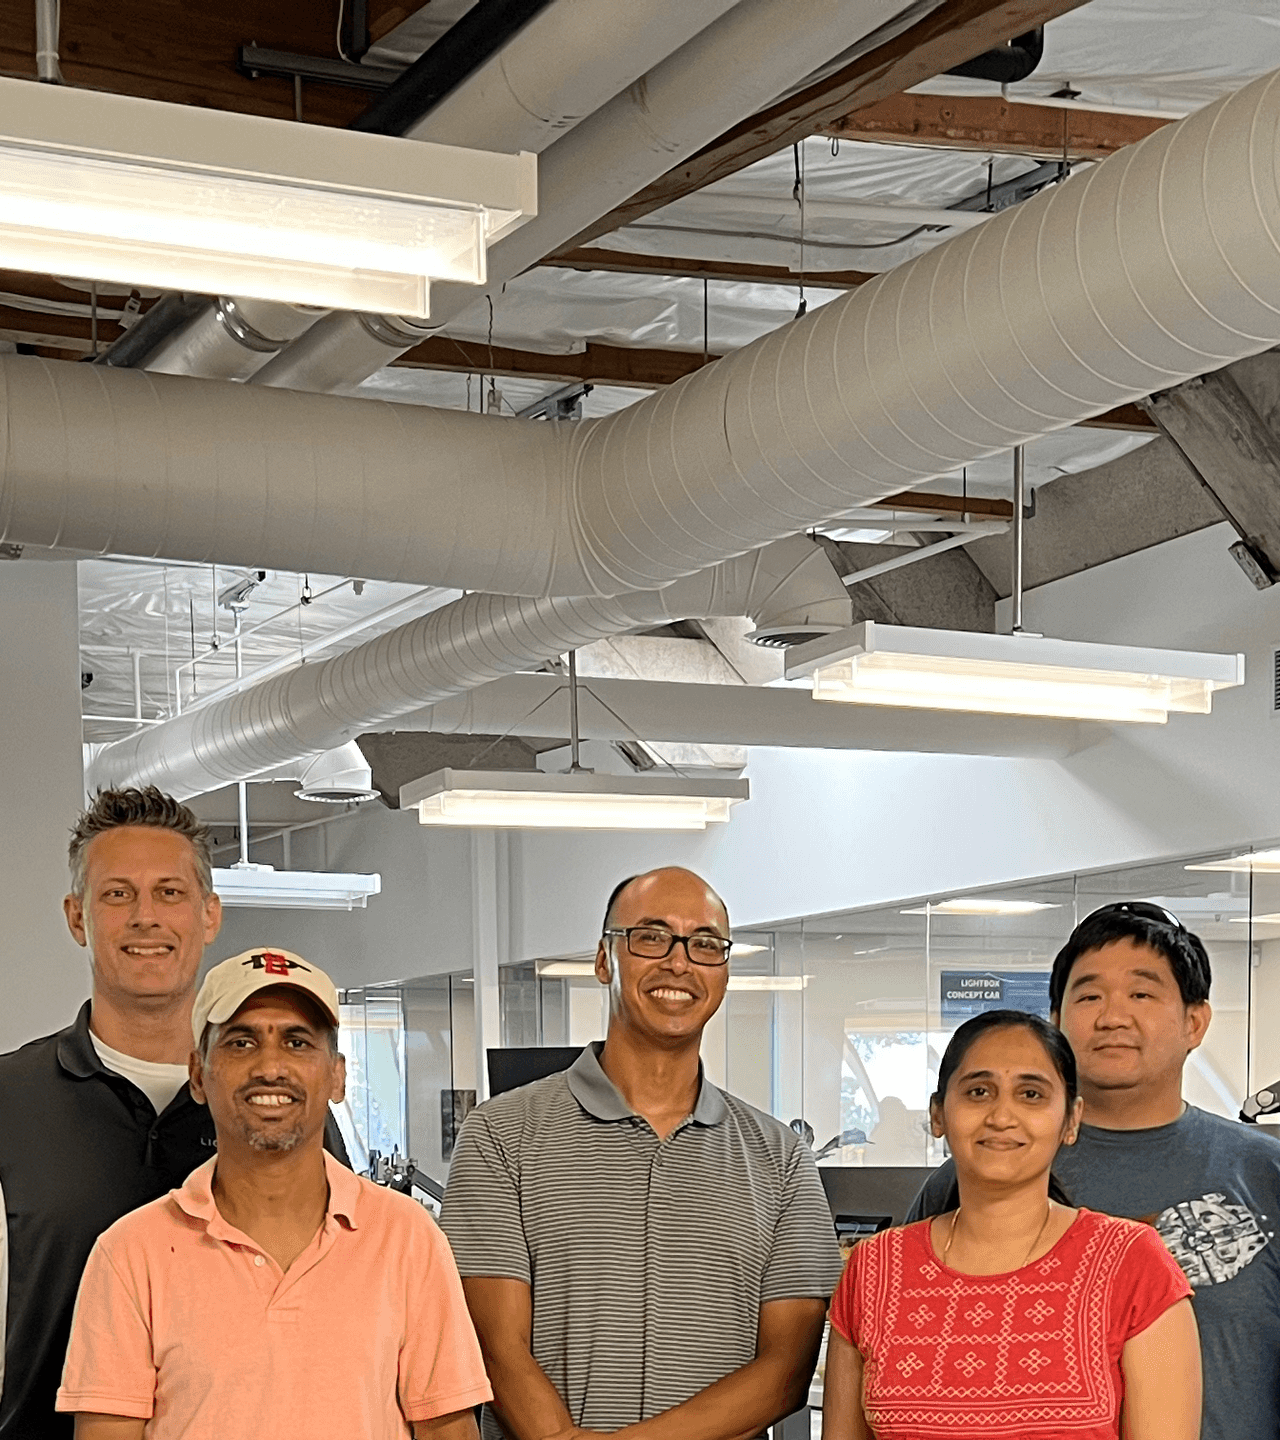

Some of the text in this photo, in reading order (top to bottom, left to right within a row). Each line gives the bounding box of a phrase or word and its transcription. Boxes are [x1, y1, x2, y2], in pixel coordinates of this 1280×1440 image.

[960, 979, 1000, 988] LIGHTBOX
[946, 990, 1000, 999] CONCEPT CAR
